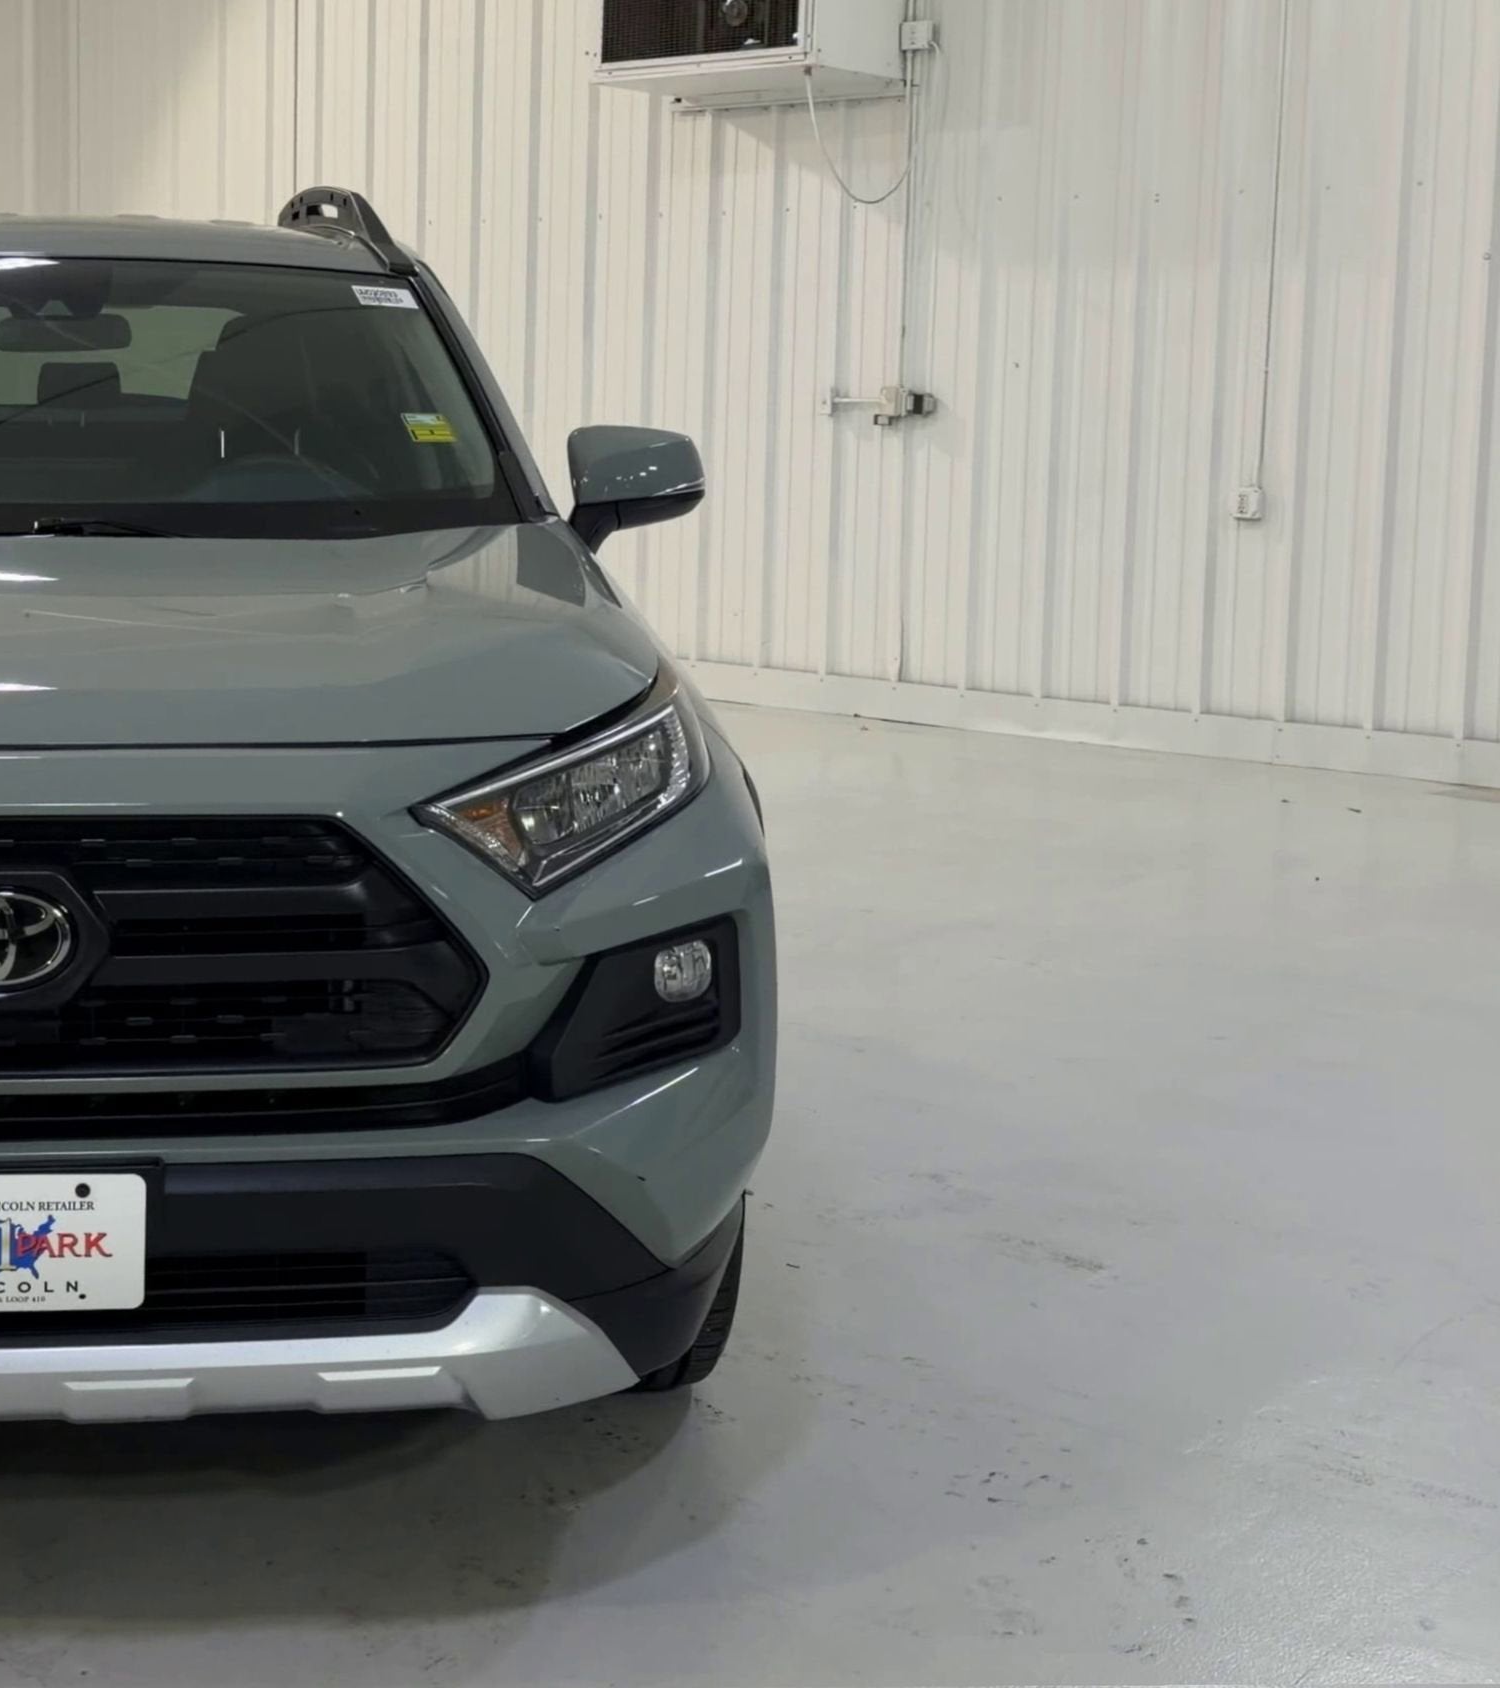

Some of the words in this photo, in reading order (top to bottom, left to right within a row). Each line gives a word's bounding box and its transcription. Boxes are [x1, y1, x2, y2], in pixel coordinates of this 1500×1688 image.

[38, 1201, 95, 1211] RETAILER
[17, 1232, 113, 1259] PARK
[6, 1295, 30, 1304] LOOP
[32, 1295, 47, 1303] 410
